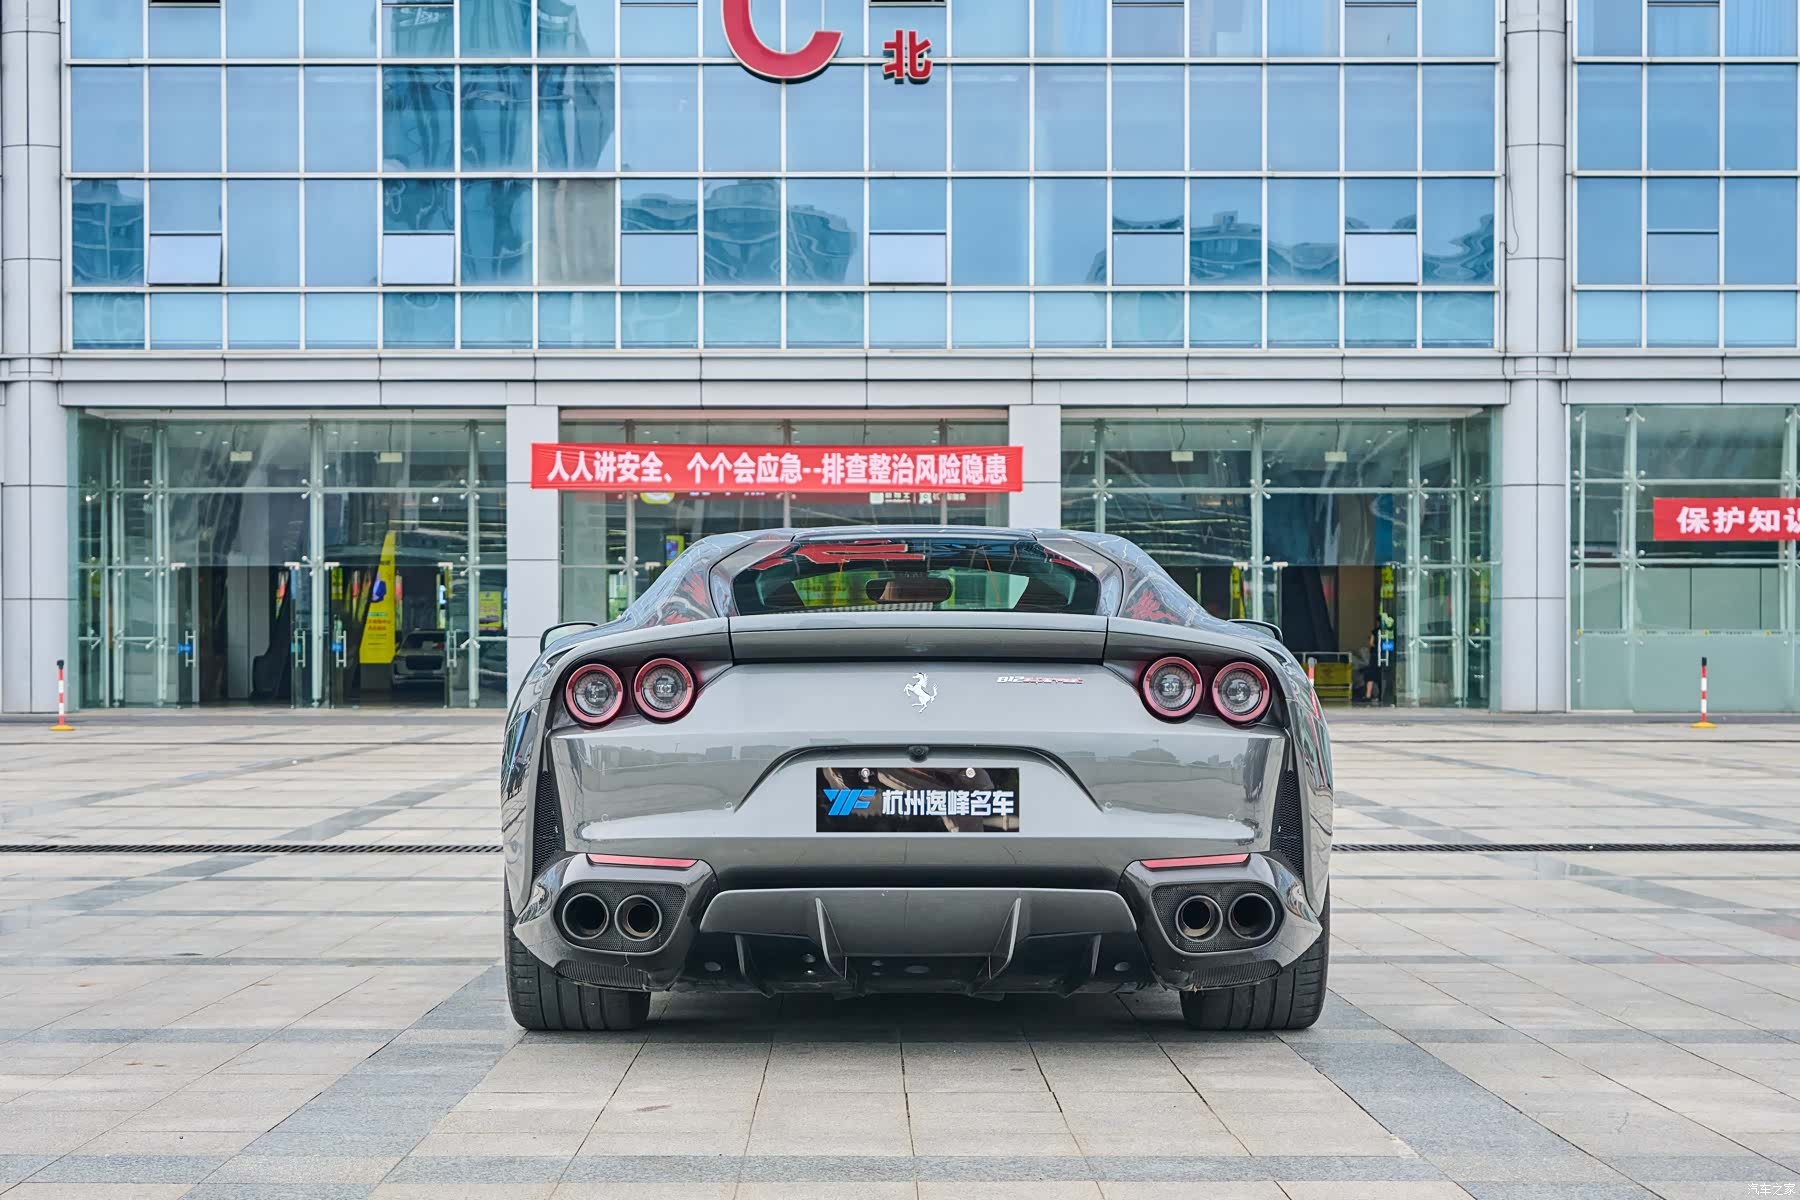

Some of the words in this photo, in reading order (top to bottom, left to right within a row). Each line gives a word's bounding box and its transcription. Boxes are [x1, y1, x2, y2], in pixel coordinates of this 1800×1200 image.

[883, 29, 933, 80] 北
[882, 789, 1014, 816] 杭州逸峰名车
